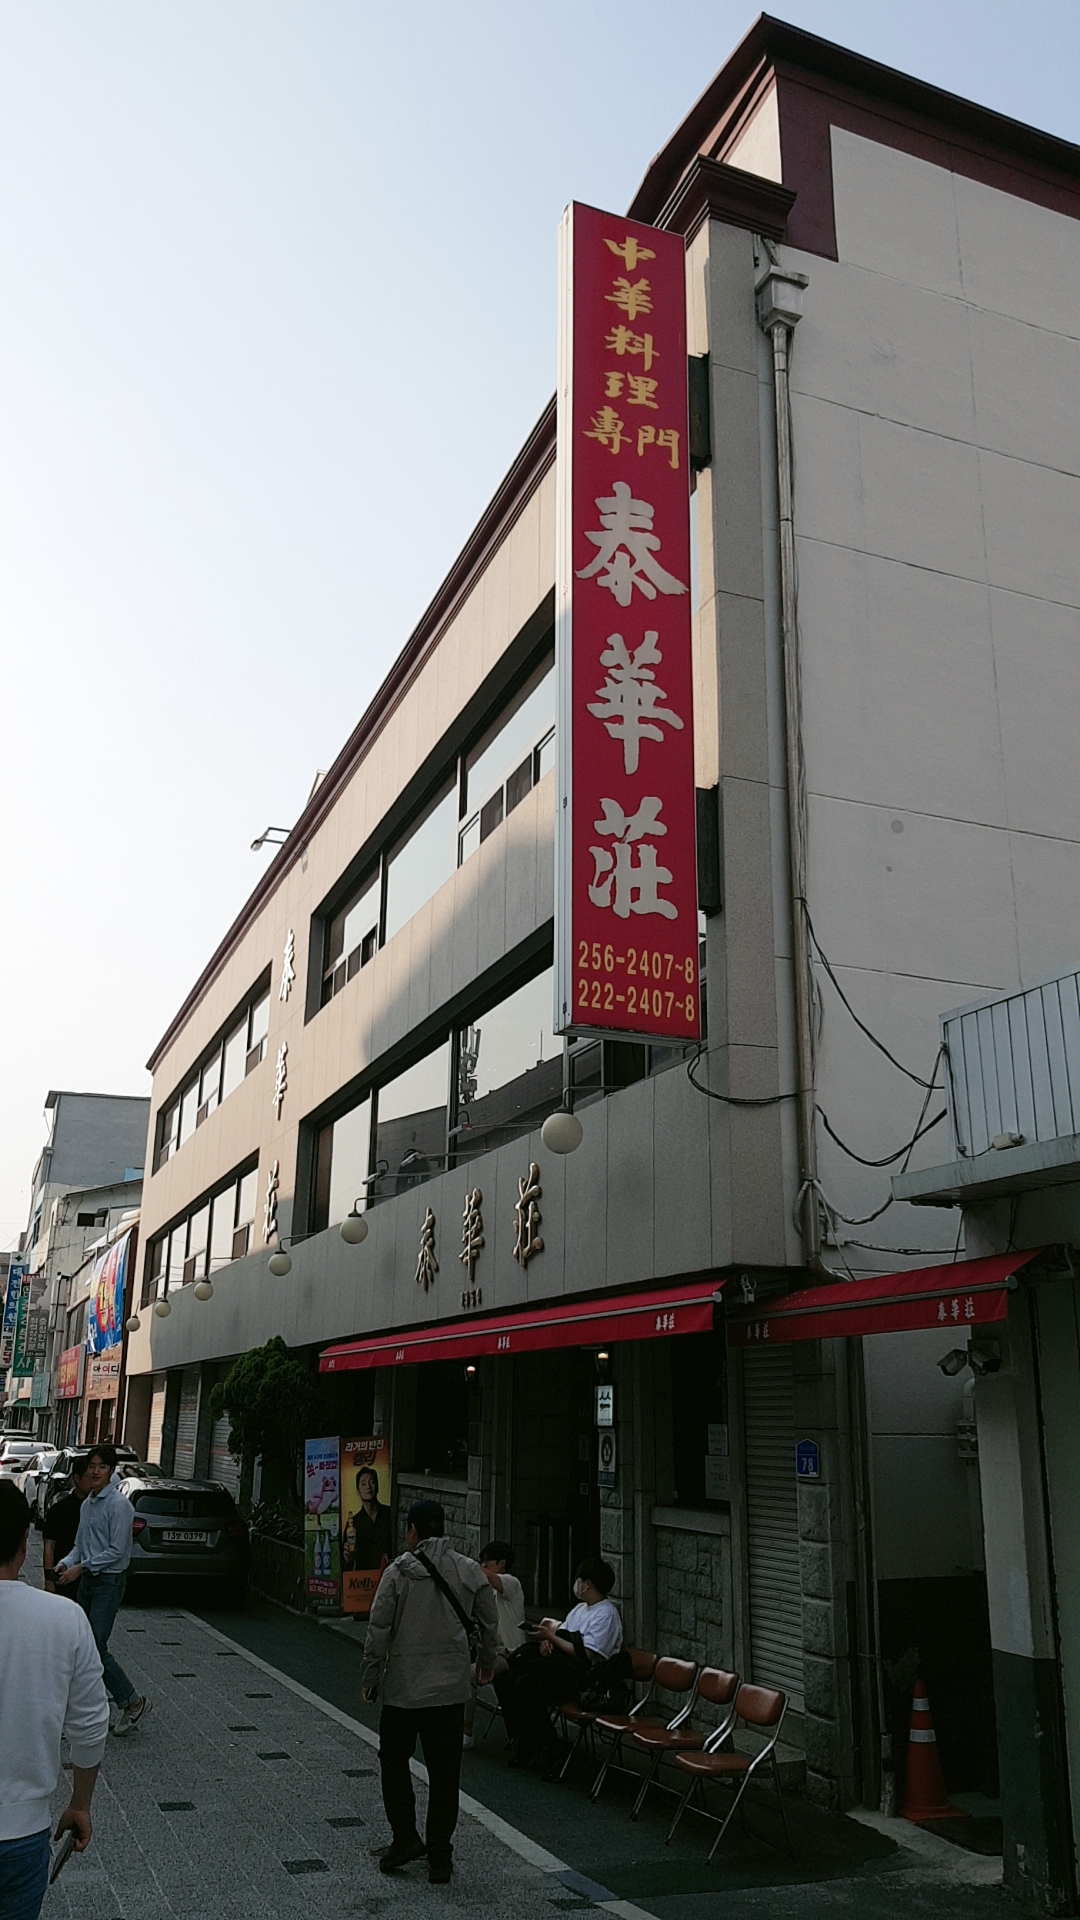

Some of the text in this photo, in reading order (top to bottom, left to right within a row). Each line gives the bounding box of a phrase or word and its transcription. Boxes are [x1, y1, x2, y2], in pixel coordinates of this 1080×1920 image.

[578, 941, 694, 984] 256-2407~8
[578, 979, 695, 1022] 222-2407~8
[801, 1457, 814, 1472] 78
[183, 1532, 204, 1540] 0379
[348, 1577, 377, 1591] Kelly
